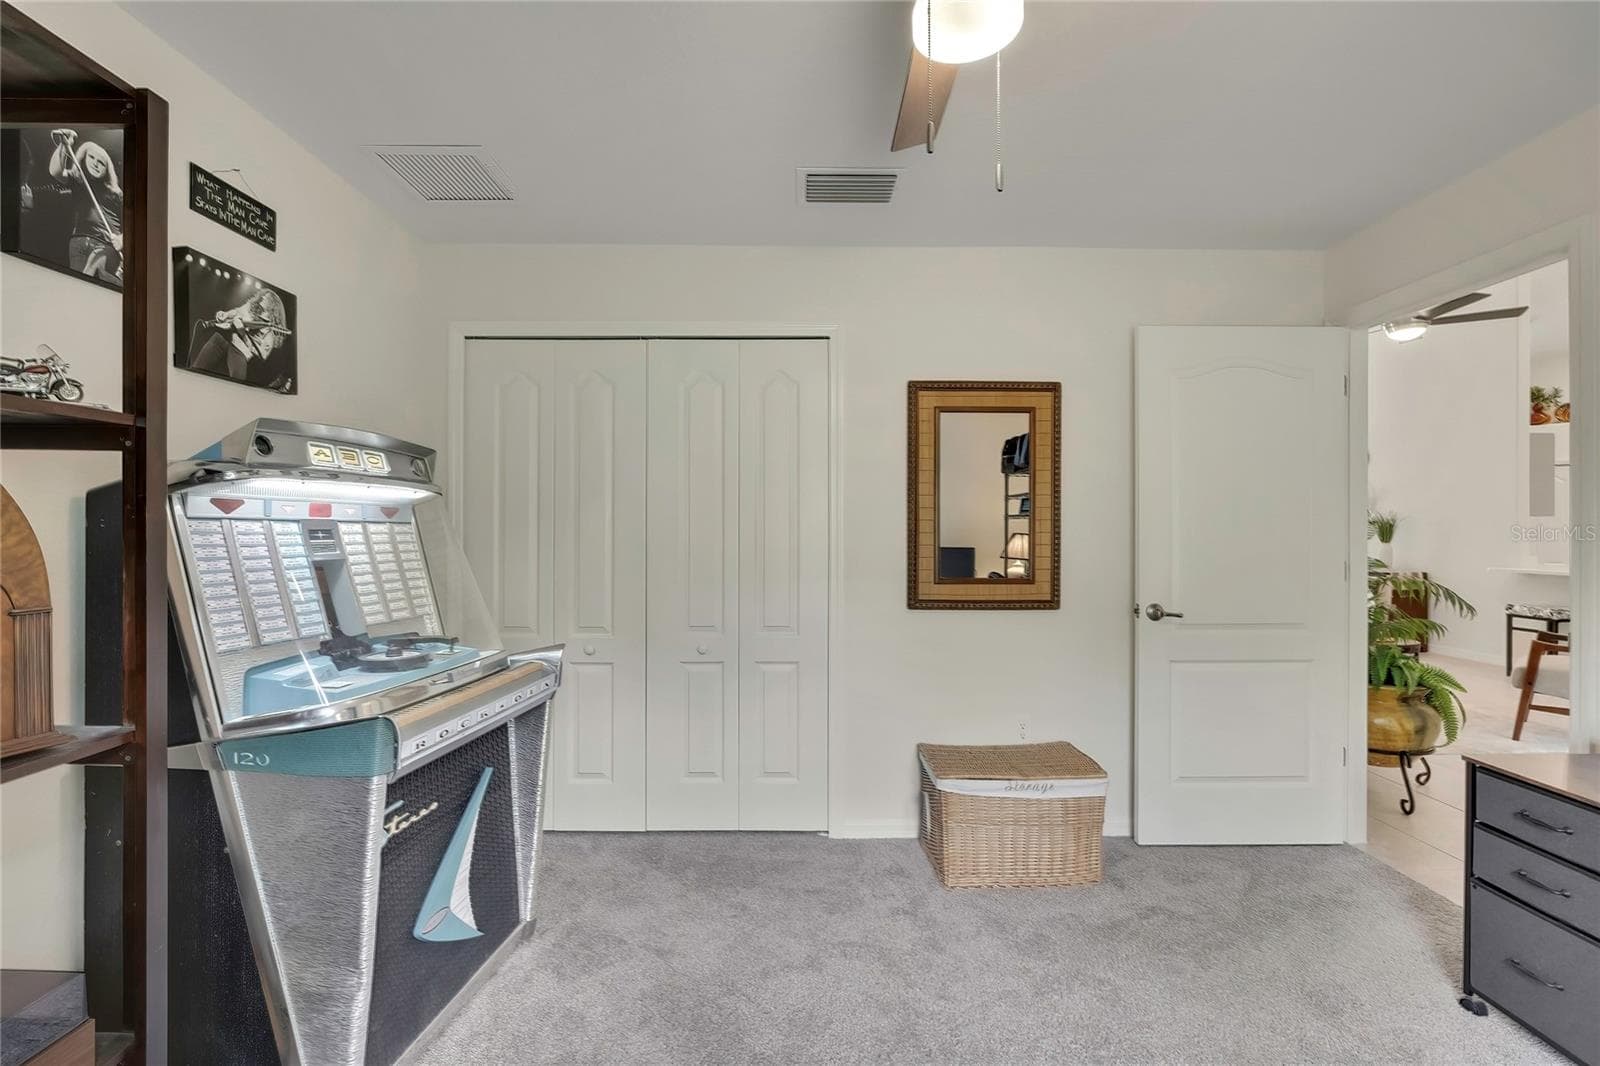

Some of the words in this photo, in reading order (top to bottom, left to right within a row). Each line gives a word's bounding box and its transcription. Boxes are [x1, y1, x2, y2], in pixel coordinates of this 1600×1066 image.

[196, 171, 221, 191] WHAT
[226, 189, 261, 216] HAPPENS
[204, 186, 224, 206] THE
[228, 200, 246, 219] MAN
[249, 213, 270, 231] CAVE
[195, 195, 218, 215] STAYS
[241, 220, 257, 237] MAN
[257, 228, 276, 245] CAVE
[233, 751, 270, 767] 120
